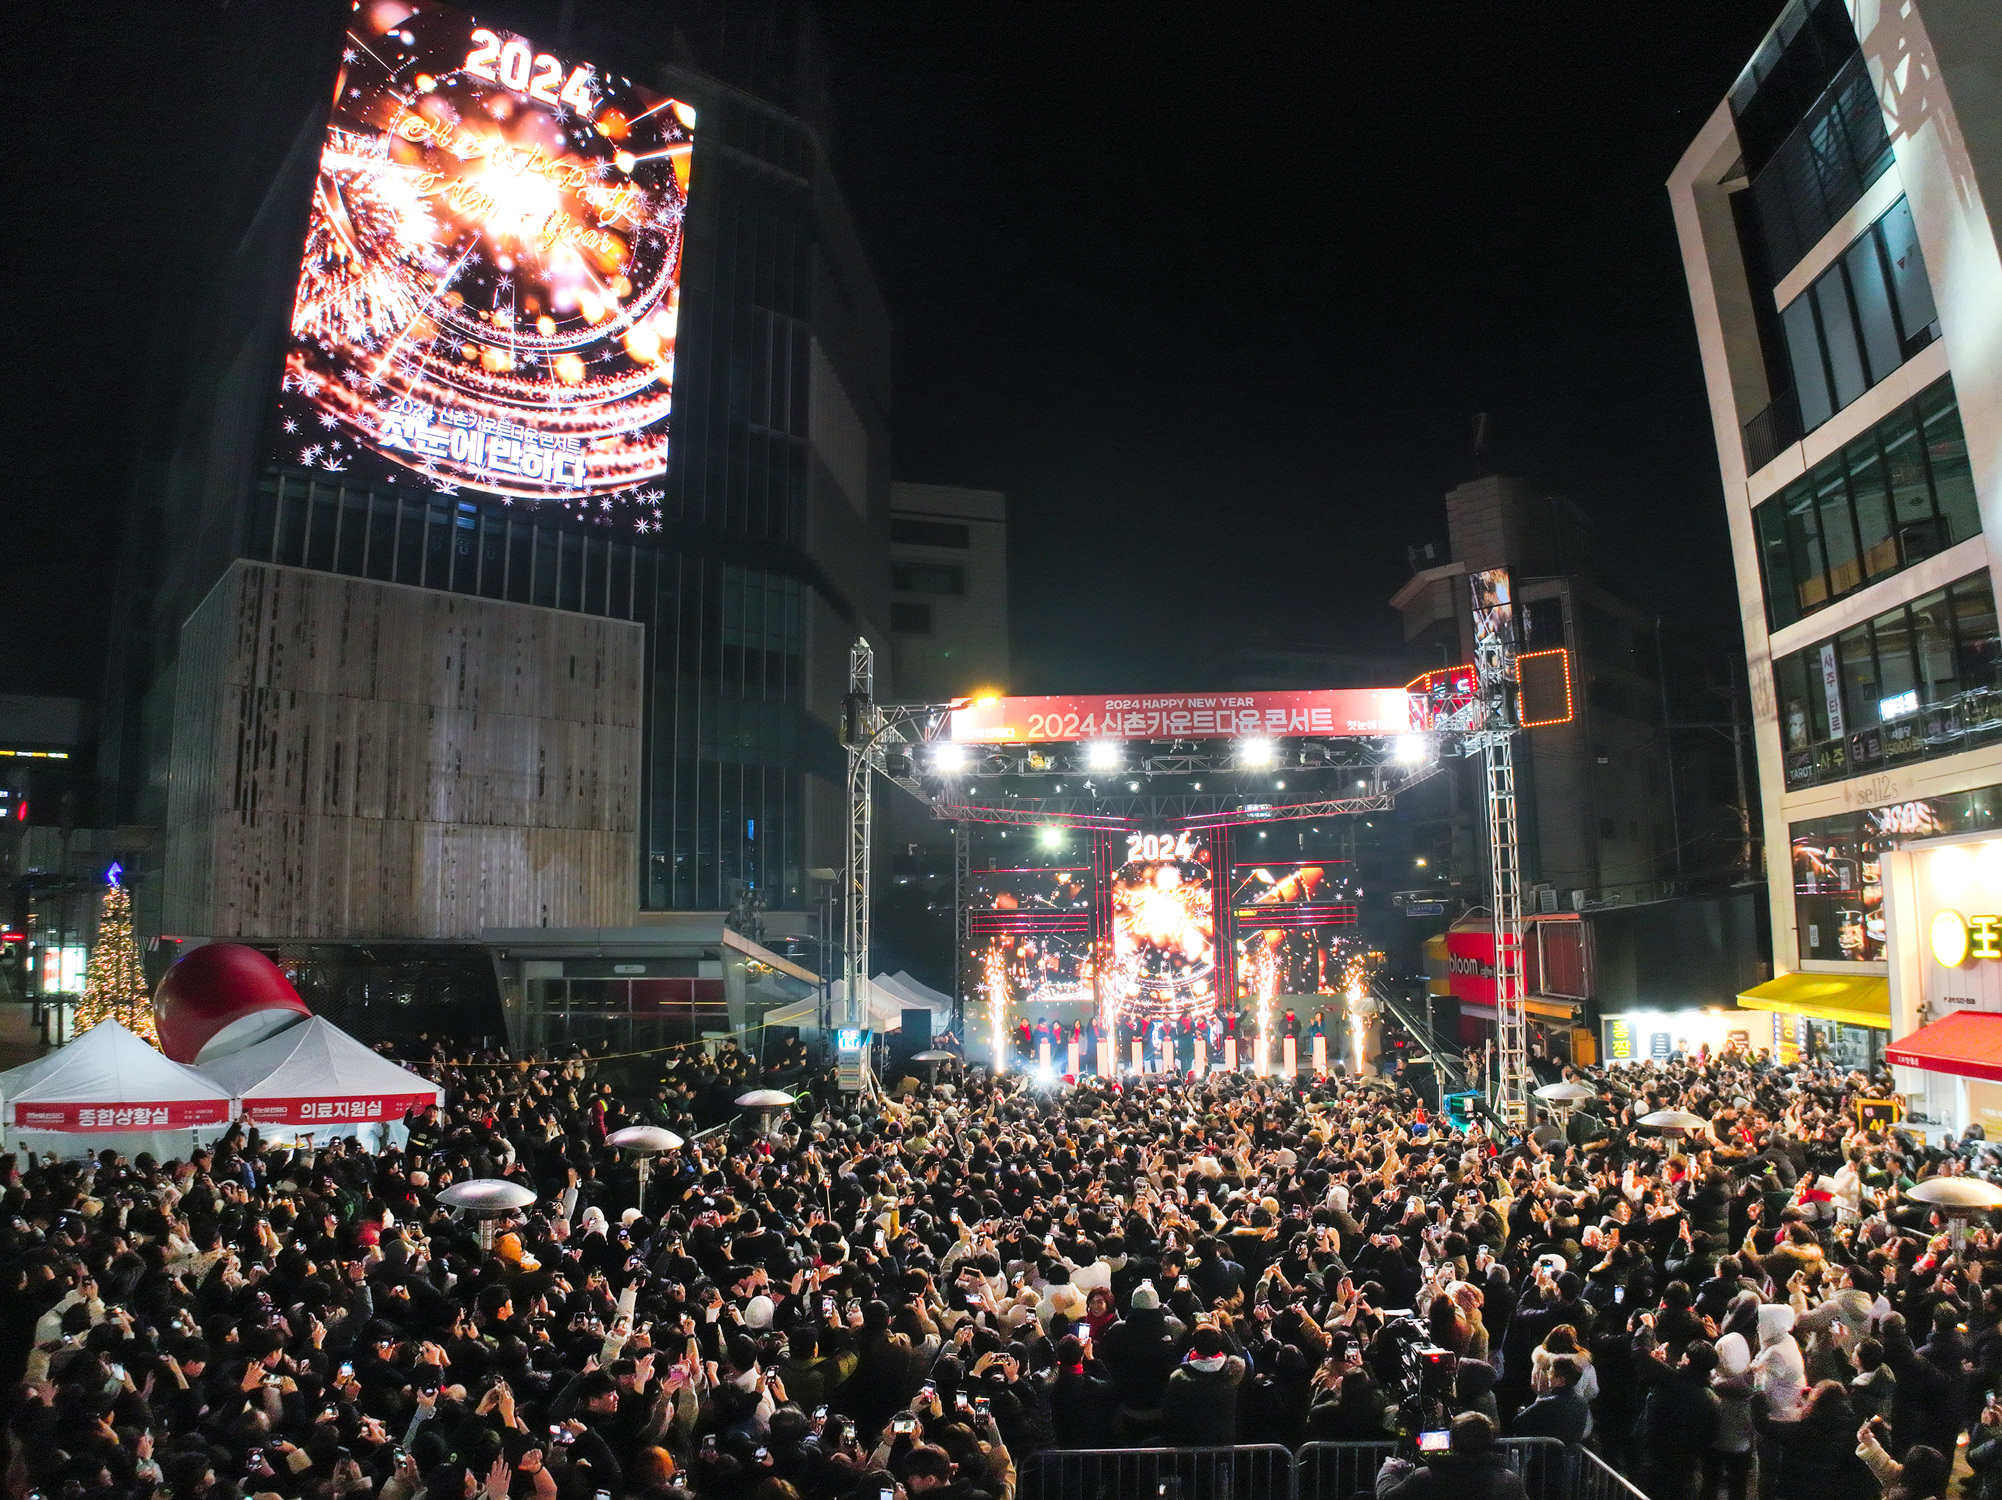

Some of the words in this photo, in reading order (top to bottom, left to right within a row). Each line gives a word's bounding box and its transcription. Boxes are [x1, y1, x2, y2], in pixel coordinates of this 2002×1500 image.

[466, 27, 598, 120] 2024
[1105, 700, 1140, 710] 2024
[1142, 699, 1183, 710] HAPPY
[1188, 698, 1216, 708] NEW
[1219, 697, 1254, 707] YEAR
[1028, 713, 1098, 738] 2024
[1790, 765, 1813, 781] TAROT
[1858, 776, 1901, 806] sell2s
[1126, 831, 1193, 863] 2024
[1449, 952, 1478, 975] bloom
[79, 1107, 169, 1127] 종합상황실
[300, 1101, 382, 1119] 의료지원실
